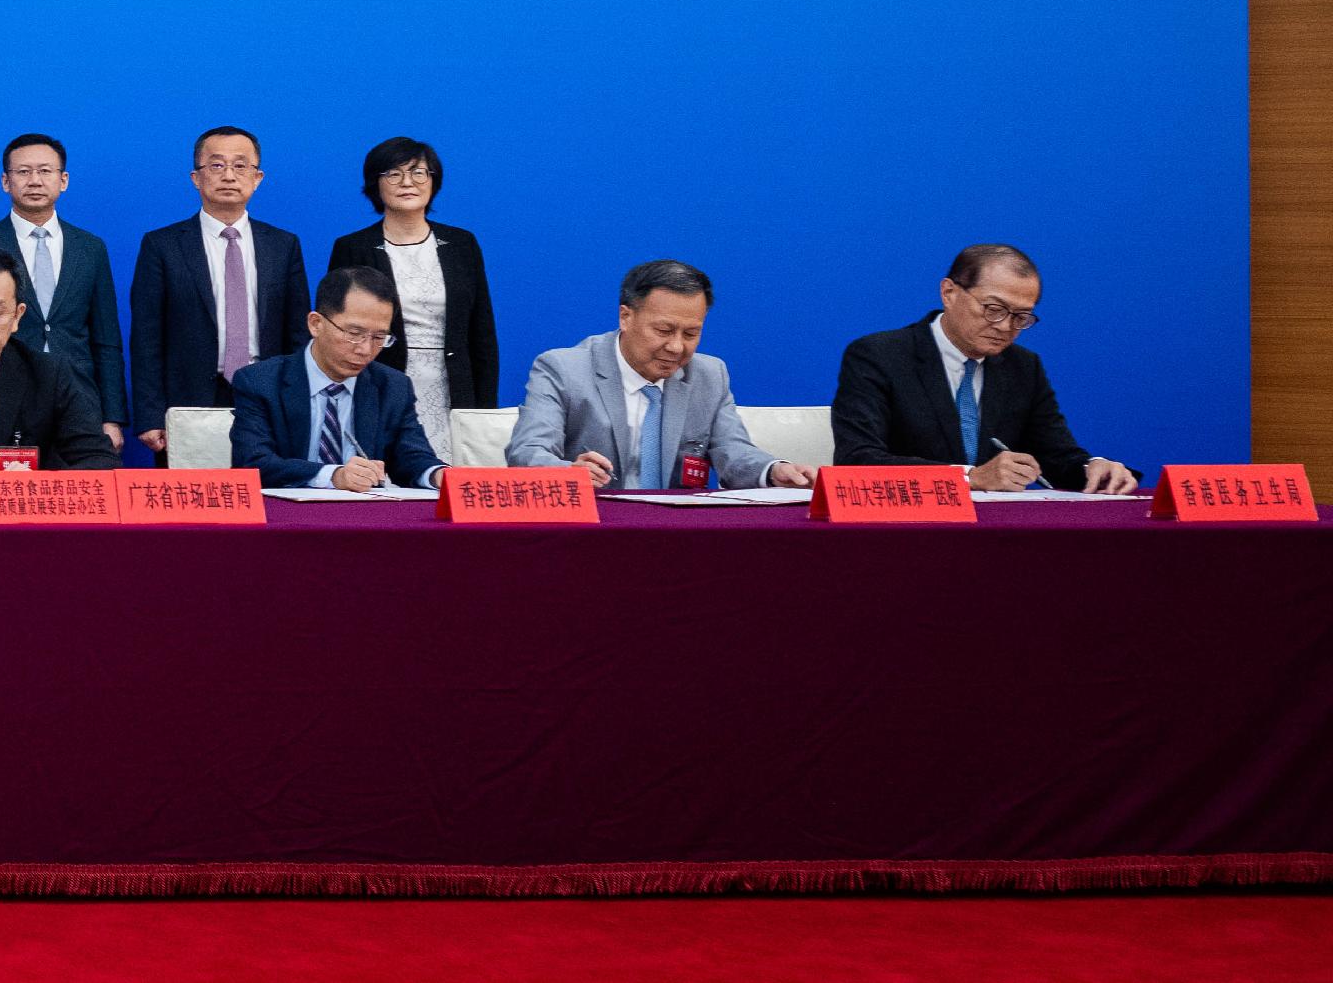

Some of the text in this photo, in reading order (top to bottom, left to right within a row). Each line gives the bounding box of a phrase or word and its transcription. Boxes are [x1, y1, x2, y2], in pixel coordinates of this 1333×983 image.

[128, 481, 253, 510] 广东省市场监管局
[458, 479, 582, 509] 香港创新科技署
[835, 479, 962, 508] 中山大学附属第一医院
[1180, 476, 1302, 506] 香港医务卫生局
